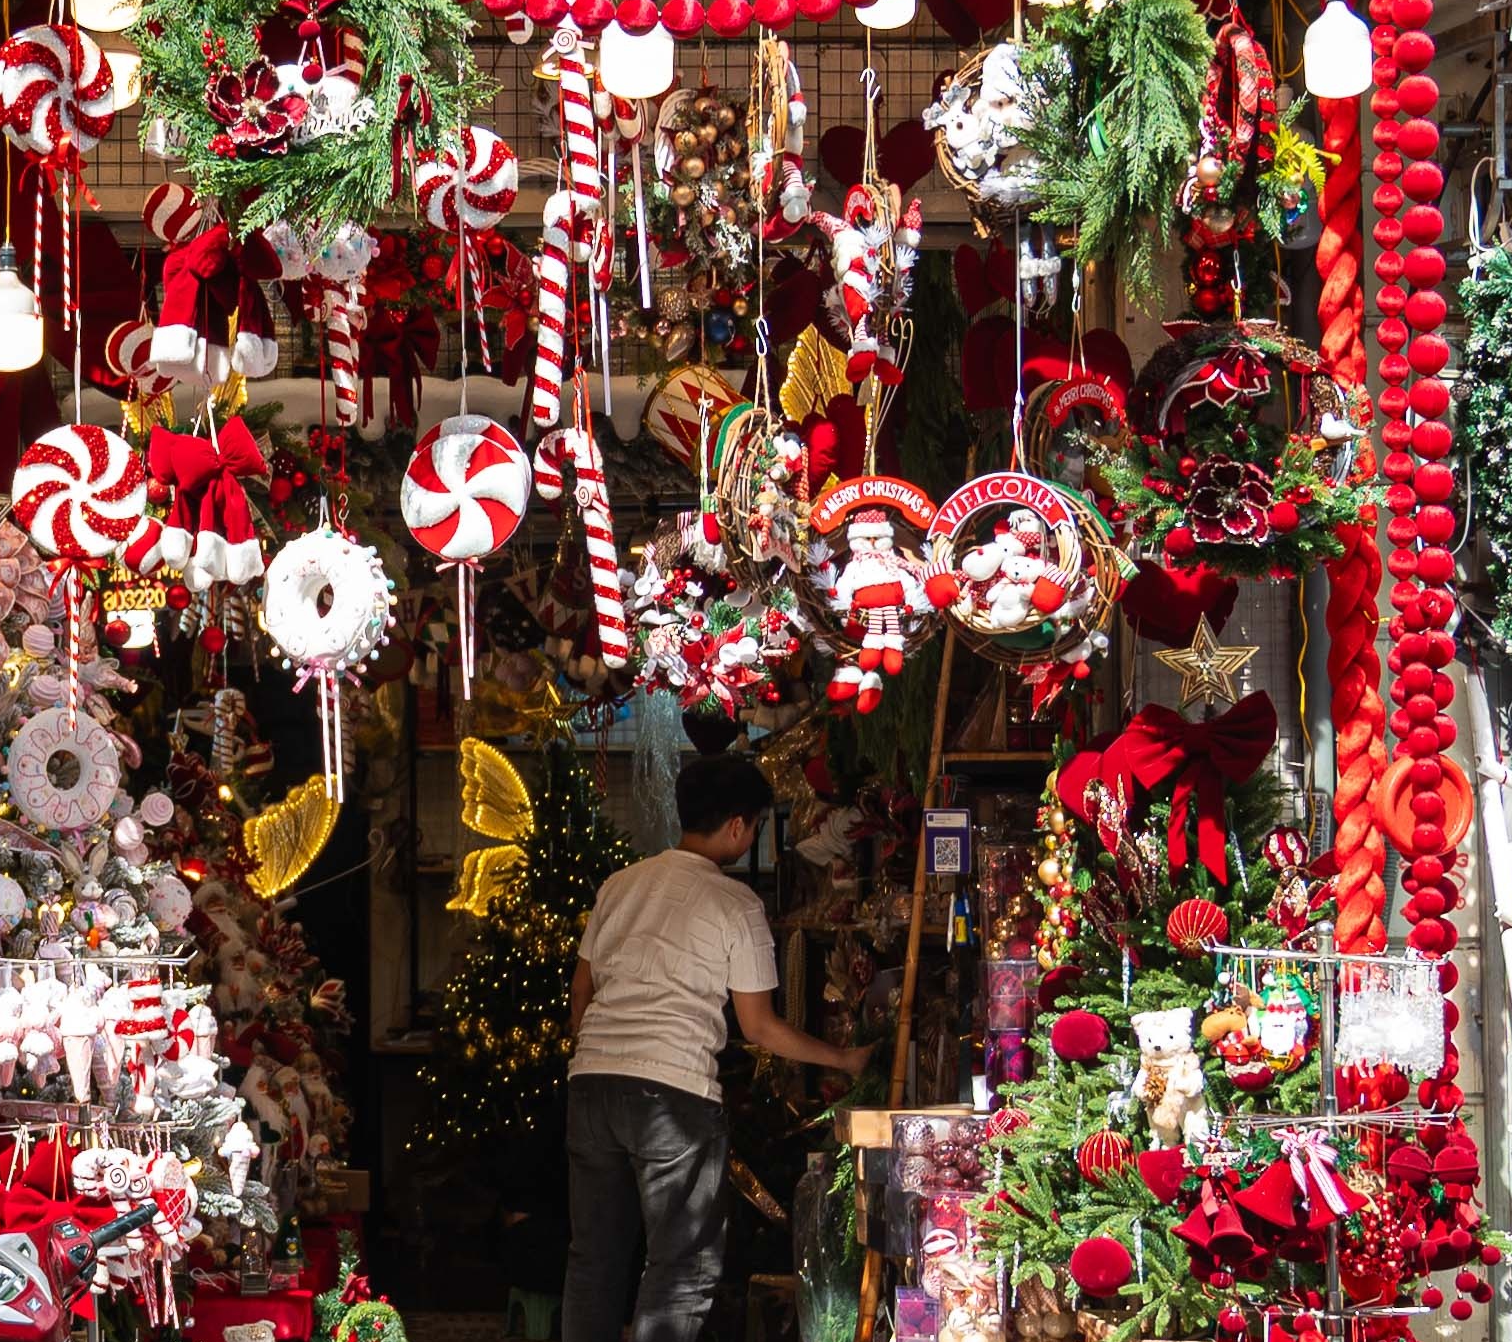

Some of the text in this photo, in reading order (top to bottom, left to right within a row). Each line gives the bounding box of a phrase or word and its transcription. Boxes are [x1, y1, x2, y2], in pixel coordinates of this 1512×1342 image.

[825, 481, 924, 512] MERRY CHRISTMAS
[939, 478, 1058, 523] WELCOME
